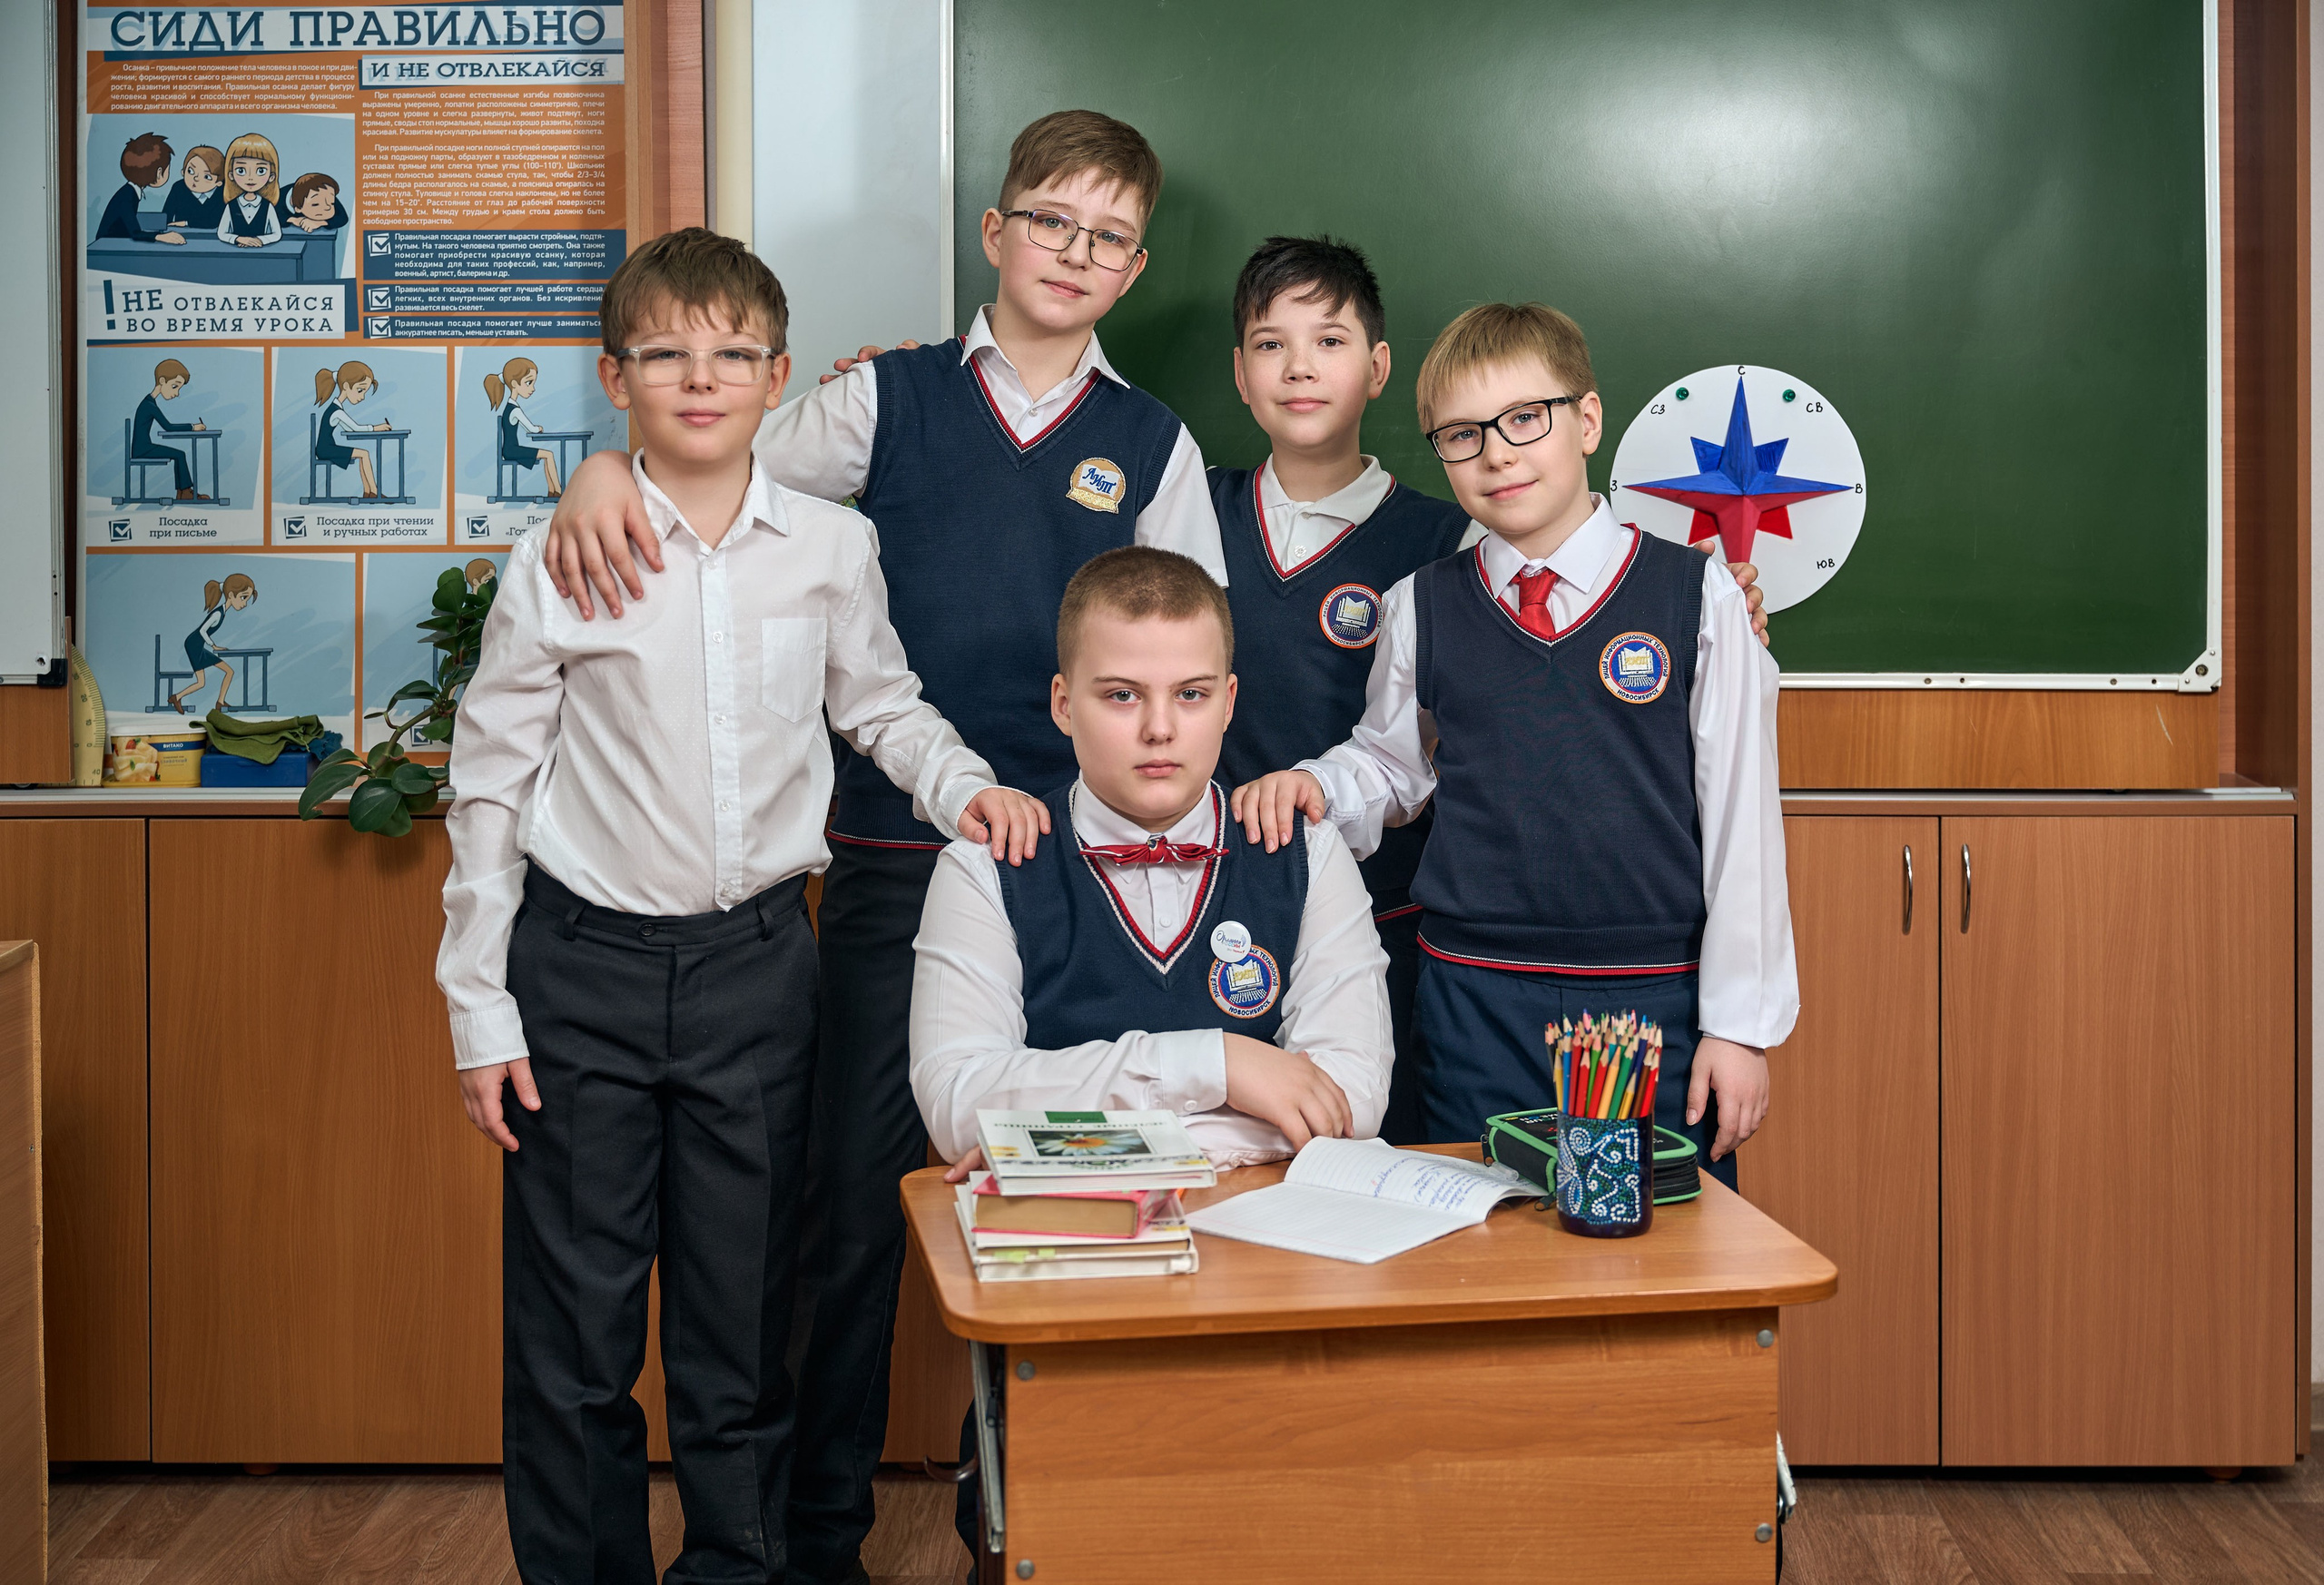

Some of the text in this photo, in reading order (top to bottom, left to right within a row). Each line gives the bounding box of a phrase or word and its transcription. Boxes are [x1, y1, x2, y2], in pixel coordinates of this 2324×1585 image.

[111, 10, 606, 51] СИДИ ПРАВИЛЬНО
[372, 60, 605, 77] И НЕ ОТВЛЕКАЙСЯ
[395, 286, 439, 294] Правильная
[516, 286, 543, 295] лучшей
[122, 289, 163, 312] НЕ
[174, 294, 333, 311] ОТВЛЕКАЙСЯ
[127, 318, 333, 332] ВО ВРЕМЯ УРОКА
[1738, 366, 1745, 376] С
[1650, 404, 1666, 415] СЗ
[1806, 402, 1823, 413] СВ
[1855, 483, 1863, 494] В
[159, 517, 207, 527] Посадка
[317, 516, 365, 526] Посадка
[369, 518, 390, 528] при
[149, 529, 217, 539] при письме
[334, 528, 377, 538] ручных
[381, 527, 428, 538] работах
[1816, 559, 1835, 569] ЮВ
[1617, 688, 1659, 700] НОВОСИБИРСК
[1229, 999, 1271, 1015] НОВОСИБИРСК
